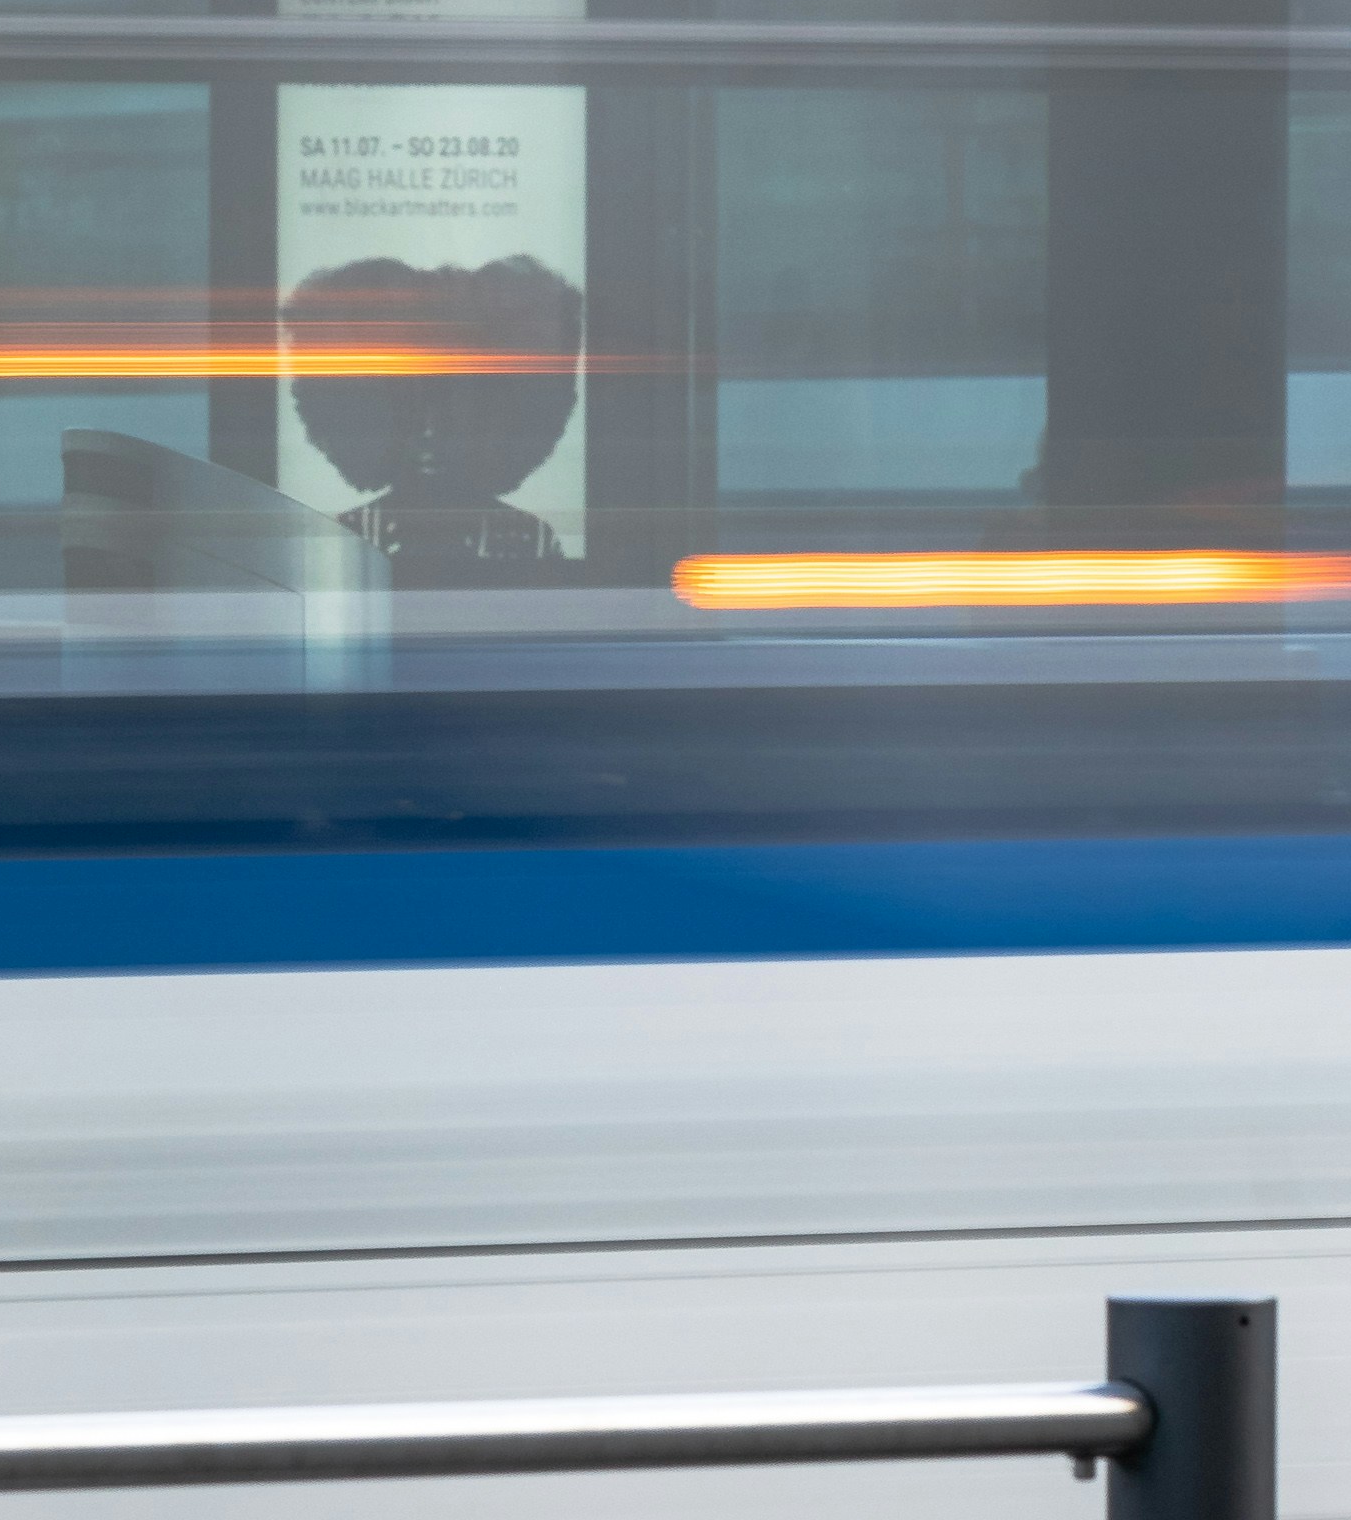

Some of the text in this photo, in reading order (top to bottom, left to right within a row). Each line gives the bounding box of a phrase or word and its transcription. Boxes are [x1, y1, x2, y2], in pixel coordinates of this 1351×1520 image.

[300, 136, 325, 157] SA
[331, 136, 386, 157] 11.07.
[408, 136, 434, 158] SO
[439, 136, 520, 158] 23.08.20
[300, 165, 518, 190] MAAG HALLE ZÜRICH
